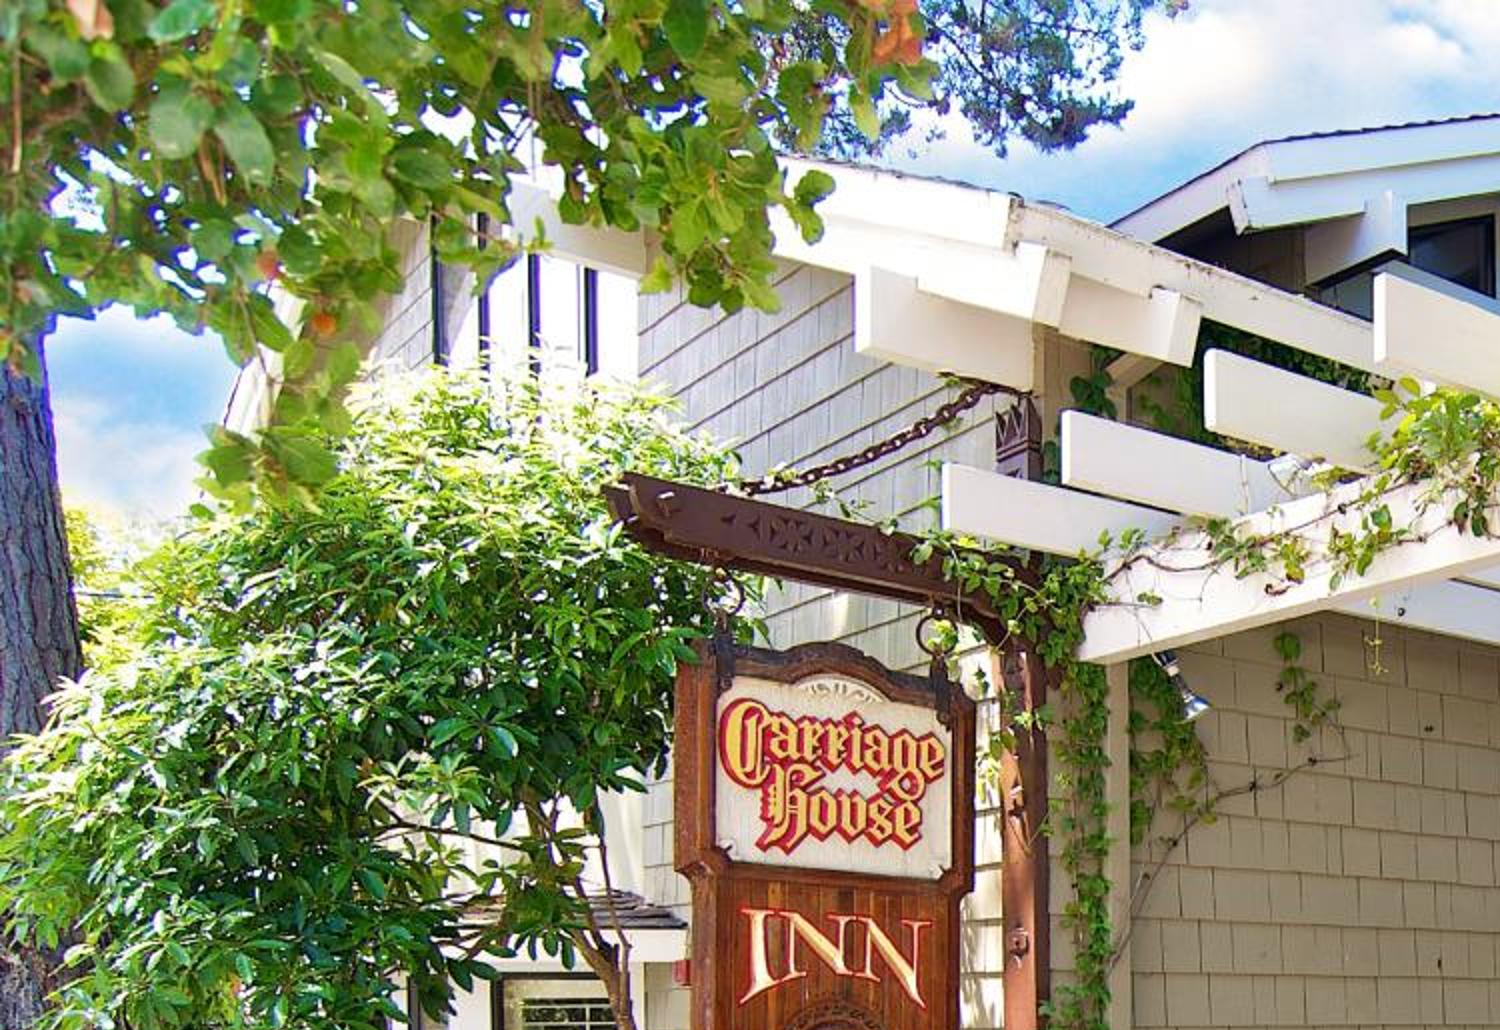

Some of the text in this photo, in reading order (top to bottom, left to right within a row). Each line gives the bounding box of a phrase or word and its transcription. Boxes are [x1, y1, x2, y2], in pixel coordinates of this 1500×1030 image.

[719, 697, 946, 801] Carriage
[756, 762, 923, 855] House
[738, 908, 932, 1009] INN
